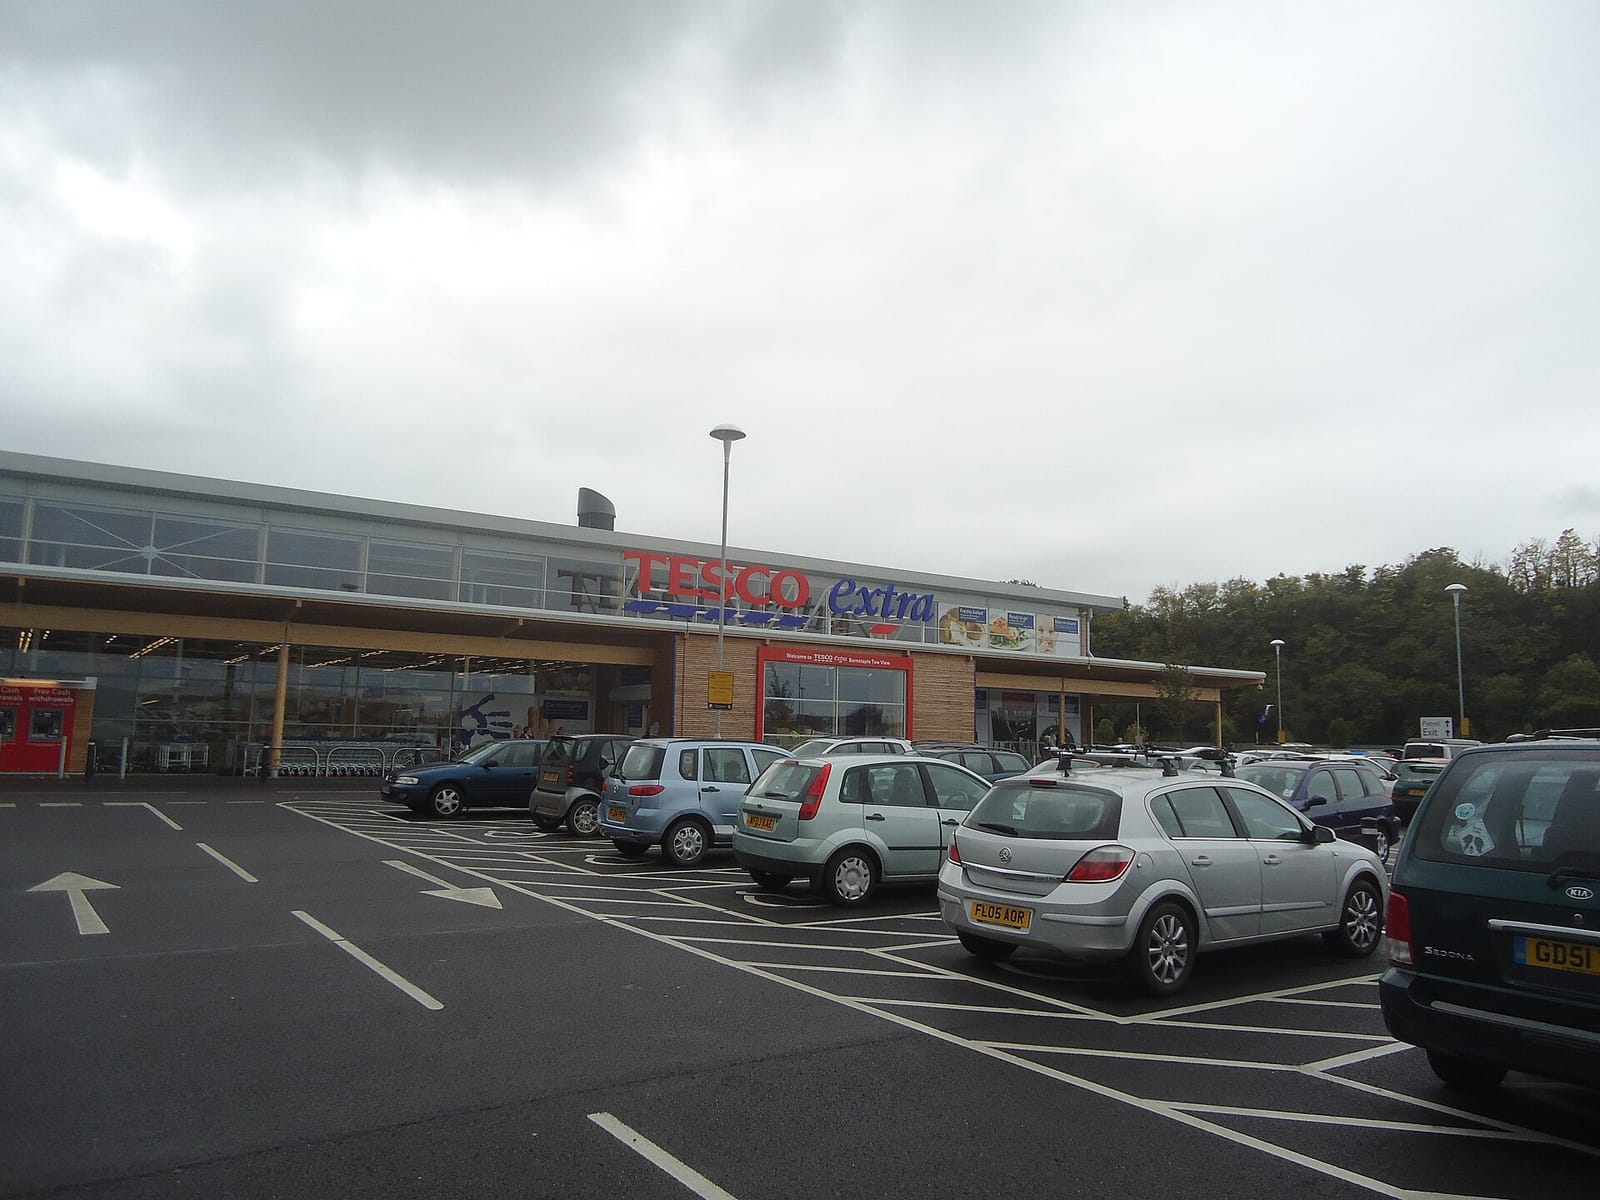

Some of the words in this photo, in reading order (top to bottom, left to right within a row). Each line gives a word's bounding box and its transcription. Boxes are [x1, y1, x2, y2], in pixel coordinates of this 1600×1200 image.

[623, 550, 810, 609] TESCO
[829, 577, 936, 622] extra
[29, 695, 74, 703] withdrawals
[1423, 728, 1438, 736] Exit
[1570, 889, 1588, 897] KIA
[975, 903, 1001, 919] FL05
[1424, 946, 1474, 961] SEDONA
[1535, 941, 1592, 969] GD51
